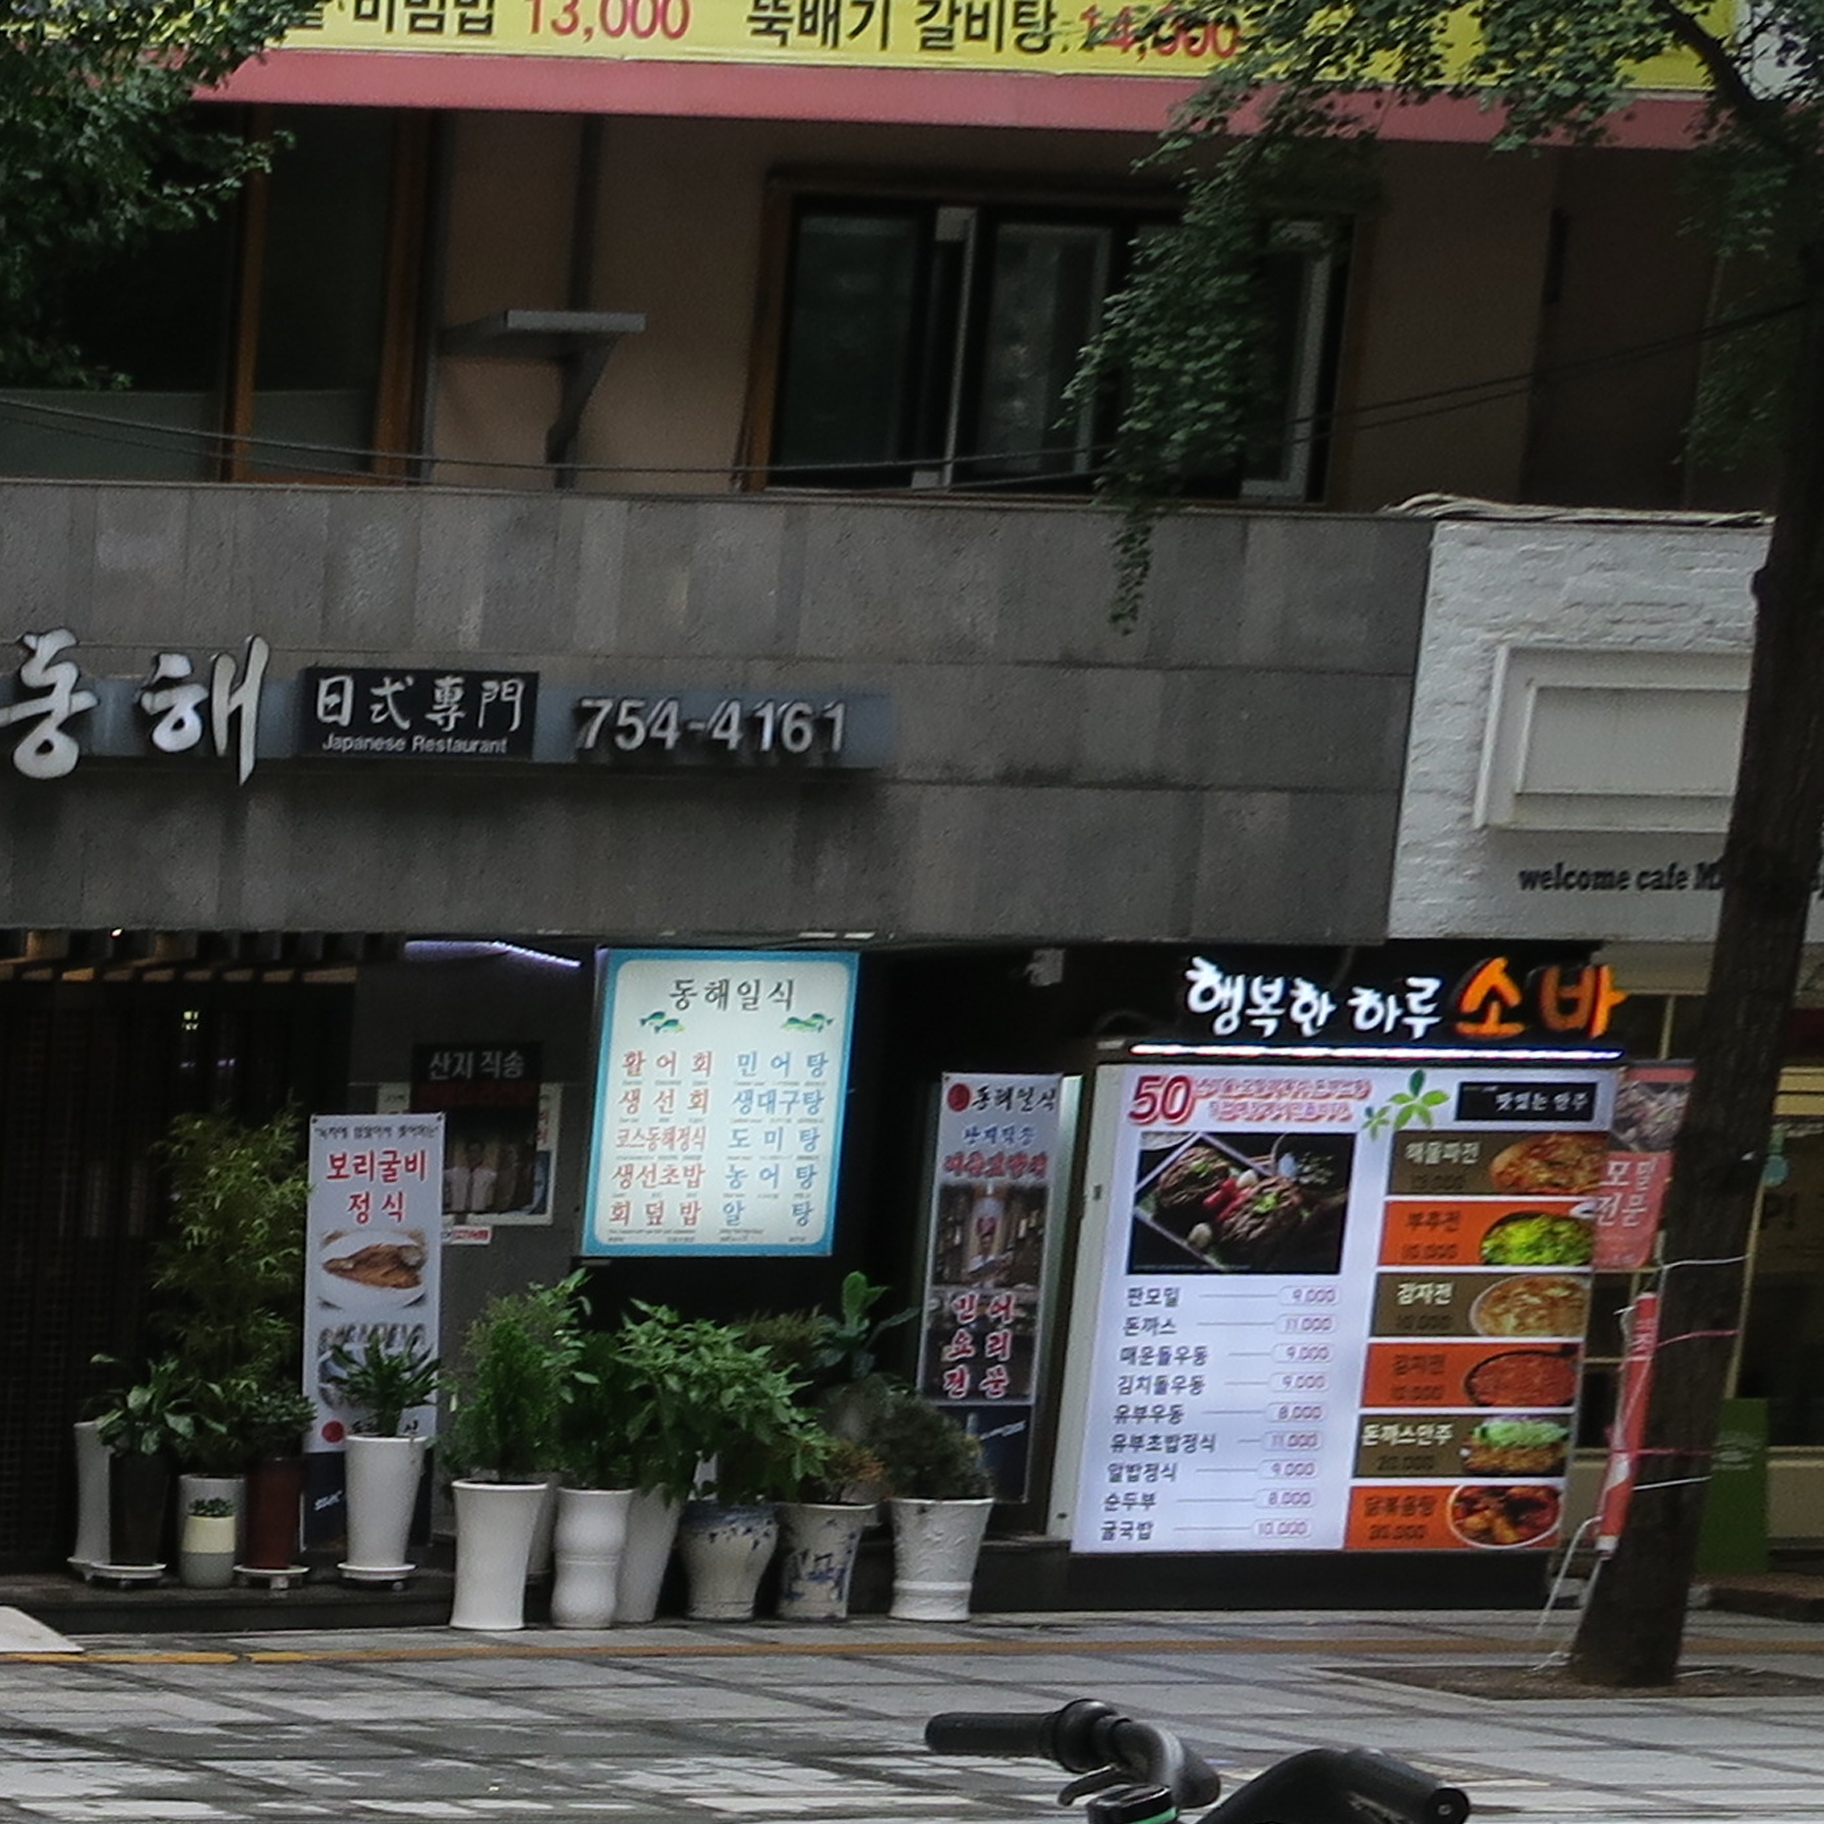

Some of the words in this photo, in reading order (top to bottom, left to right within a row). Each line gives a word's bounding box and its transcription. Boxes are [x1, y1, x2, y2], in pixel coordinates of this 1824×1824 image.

[914, 0, 1057, 53] 갈비탕
[315, 675, 526, 731] 日式專門
[576, 698, 846, 754] 754-4161
[320, 733, 406, 752] Japanese
[412, 734, 509, 753] Restaurant
[1519, 862, 1630, 891] welcome
[1636, 863, 1688, 891] cafe
[669, 979, 795, 1013] 동해일식
[1187, 956, 1340, 1039] 행복한
[1348, 978, 1443, 1040] 하루
[1455, 957, 1631, 1041] 소바
[738, 1051, 829, 1079] 민어탕
[620, 1088, 710, 1116] 생선회
[733, 1088, 824, 1116] 생대구탕
[1129, 1075, 1194, 1126] 50
[729, 1125, 821, 1153] 도미탕
[326, 1149, 425, 1183] 보리굴비
[612, 1162, 706, 1191] 생선초밥
[347, 1191, 404, 1224] 정식
[1128, 1286, 1181, 1308] 판모밀
[1123, 1315, 1178, 1337] 돈까스
[1113, 1403, 1185, 1425] 유부우동
[1110, 1433, 1216, 1454] 유부초밥정식
[1362, 1422, 1454, 1447] 돈까스안주
[1107, 1462, 1178, 1483] 알밥정식
[1103, 1491, 1157, 1512] 순두부
[1100, 1520, 1155, 1542] 굴국밥
